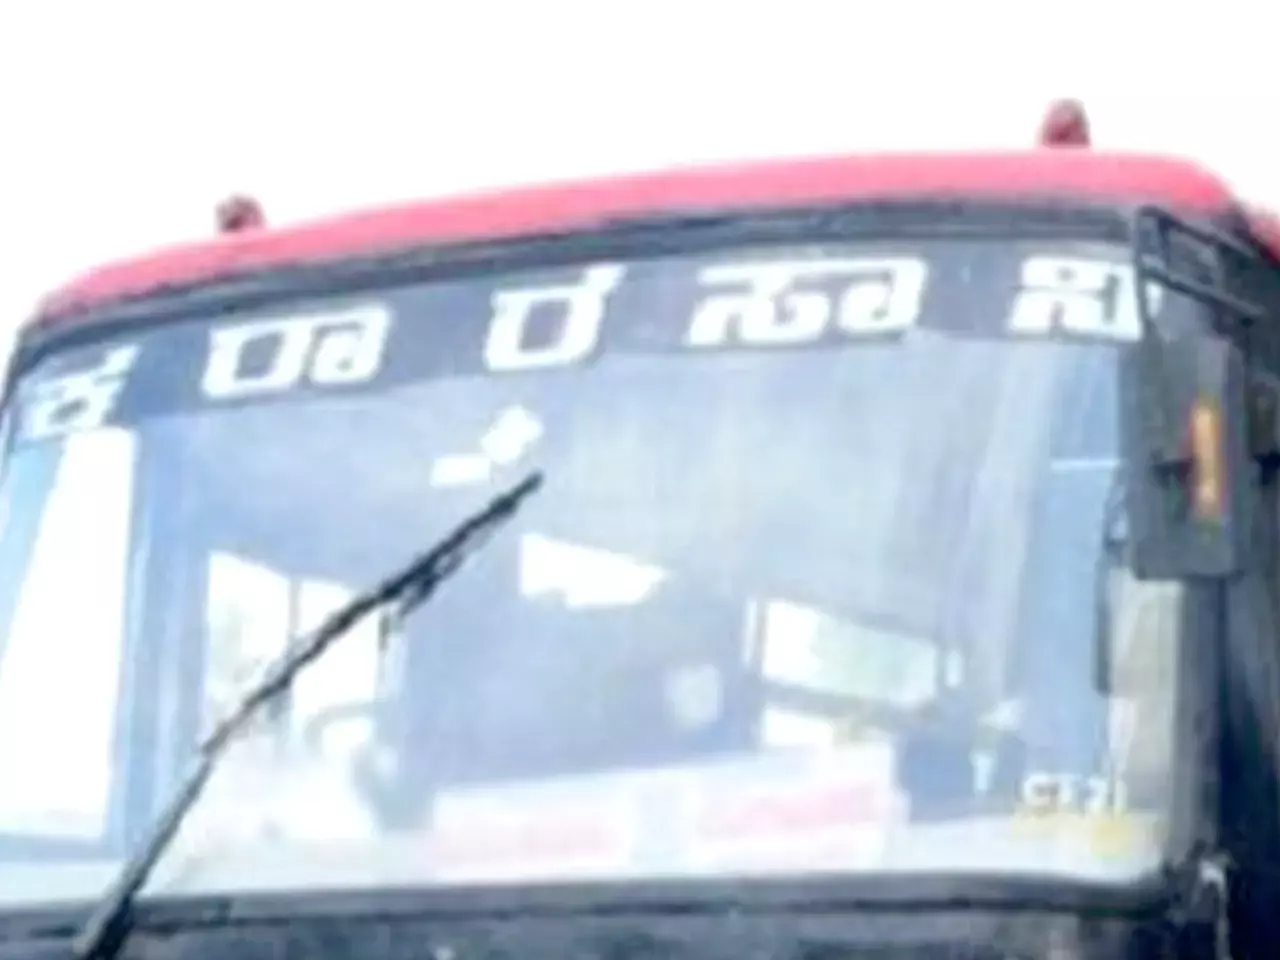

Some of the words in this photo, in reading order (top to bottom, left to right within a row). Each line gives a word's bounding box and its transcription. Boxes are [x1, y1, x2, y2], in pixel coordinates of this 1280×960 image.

[202, 305, 389, 398] ರಾ
[483, 264, 626, 370] ರ
[684, 259, 926, 345] ಸಾ
